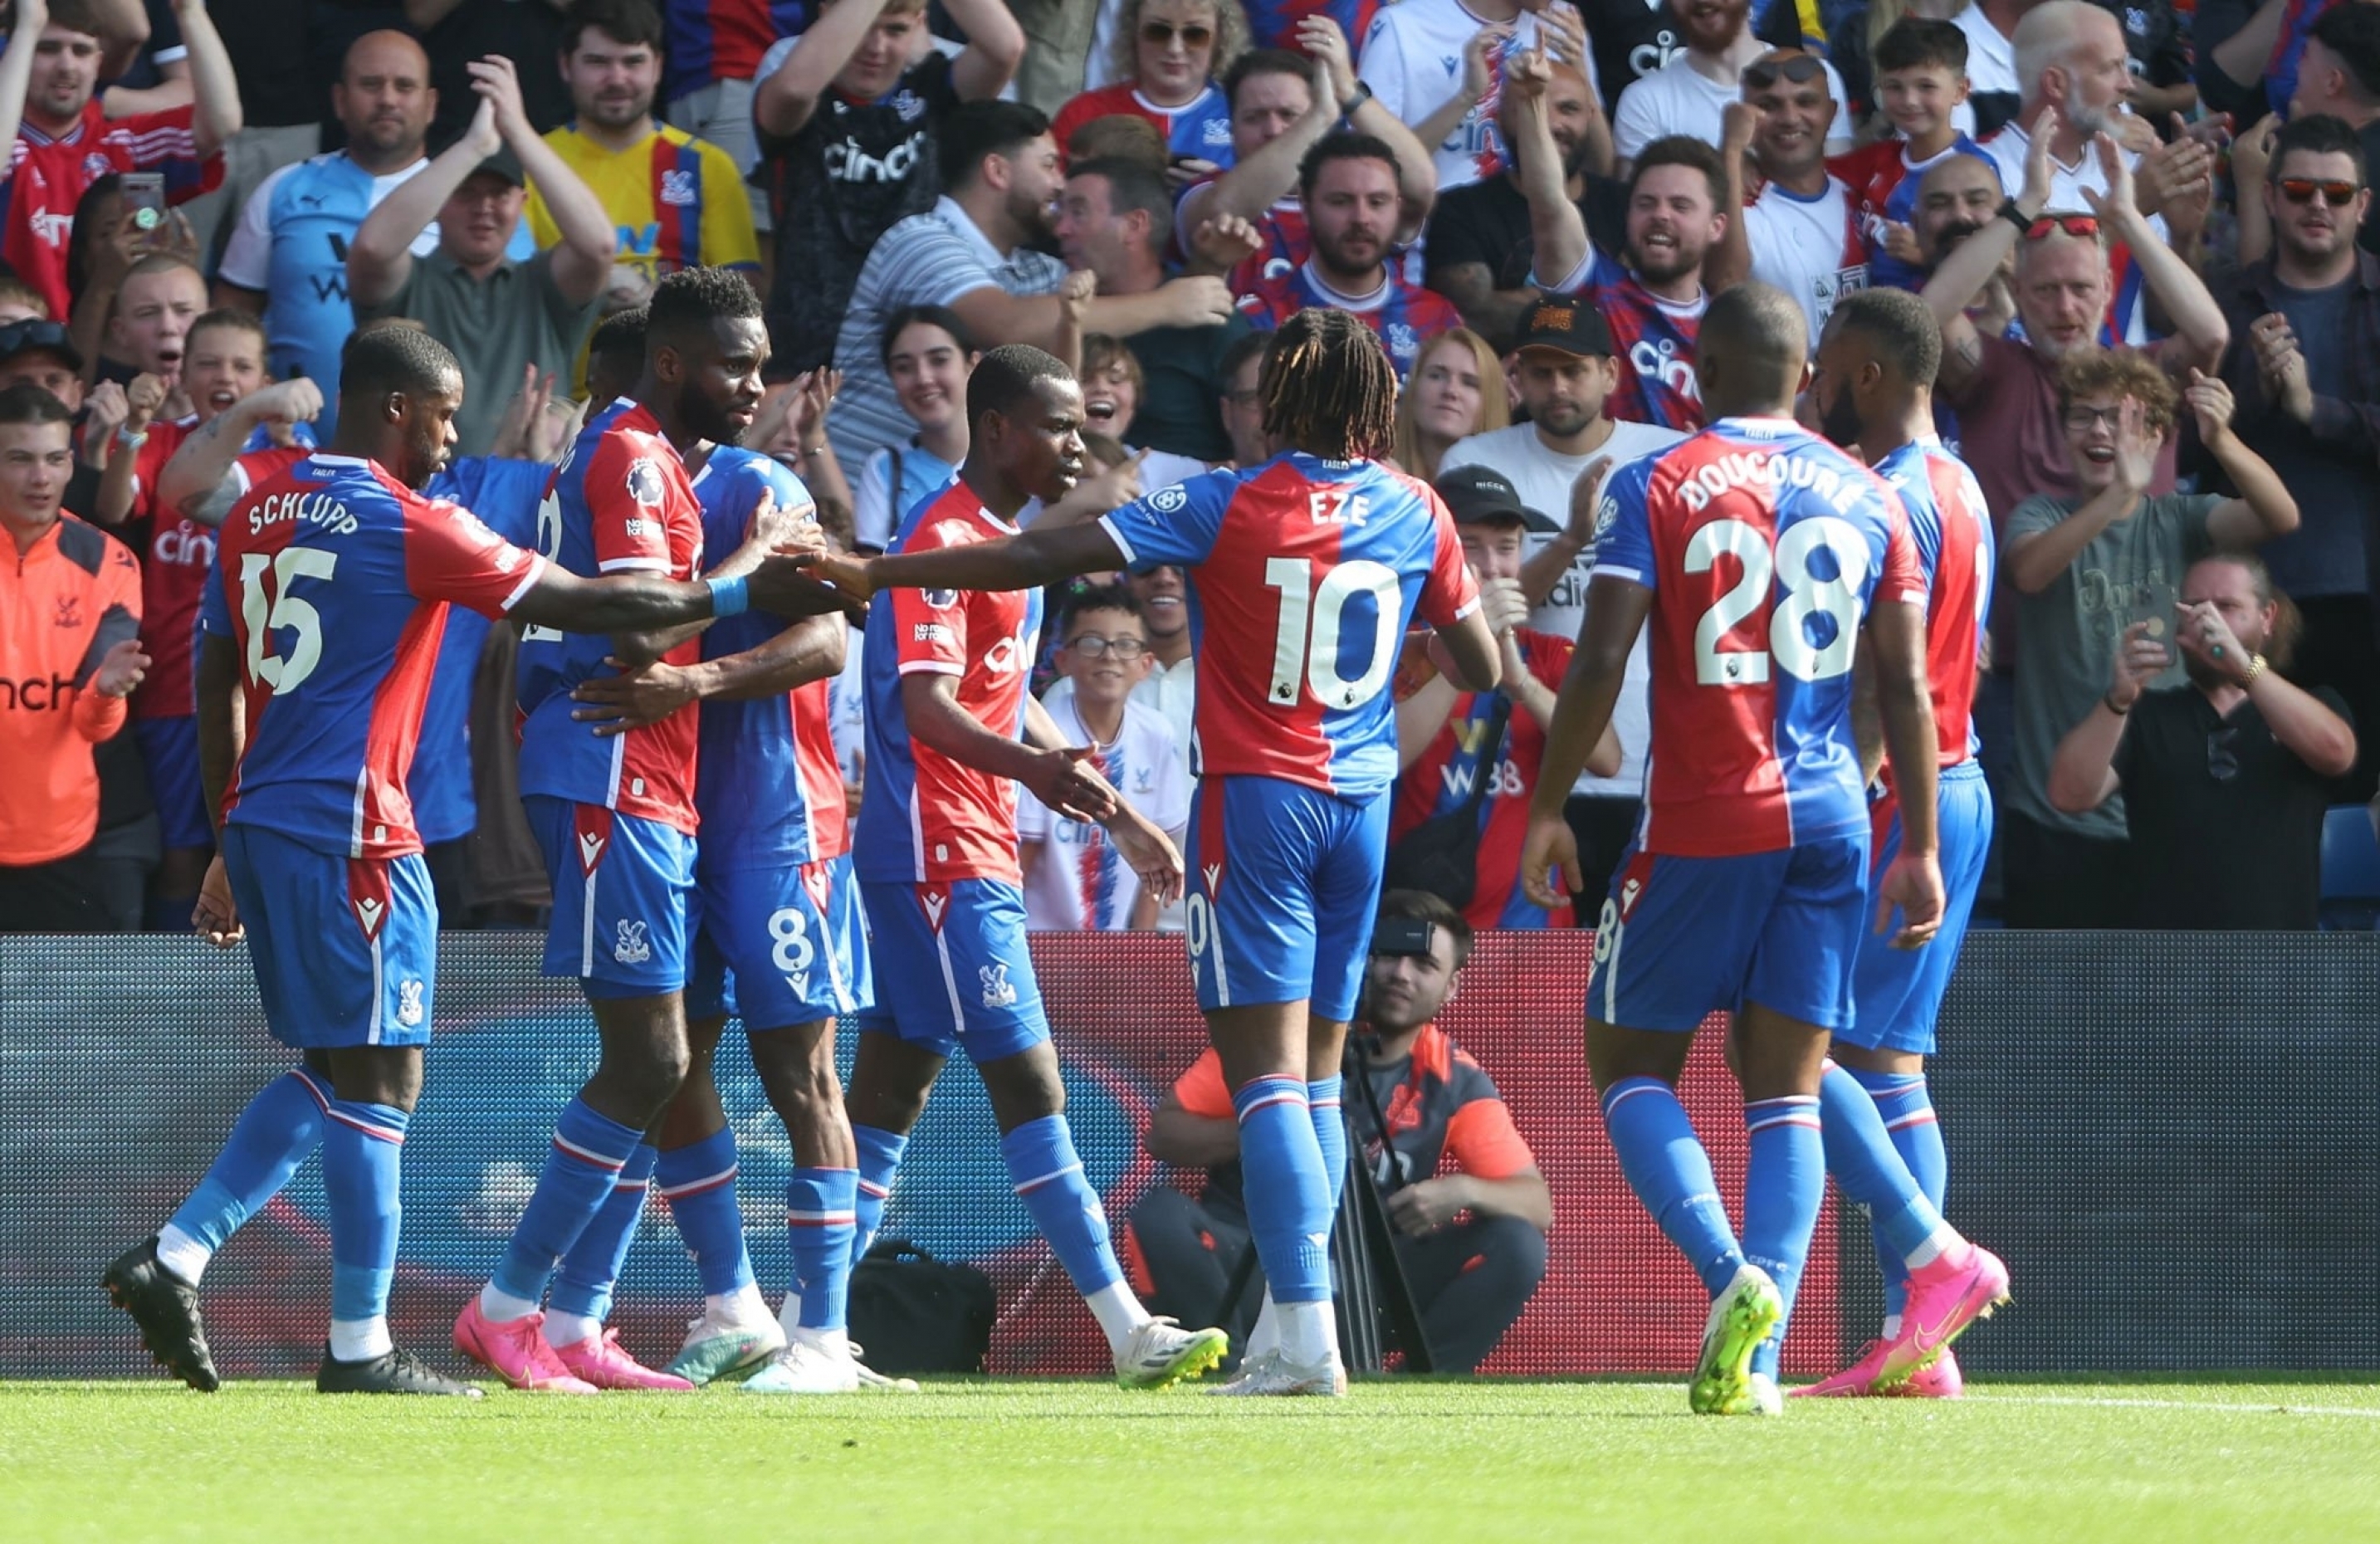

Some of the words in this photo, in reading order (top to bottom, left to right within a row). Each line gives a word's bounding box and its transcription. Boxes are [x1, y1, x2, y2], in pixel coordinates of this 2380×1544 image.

[248, 491, 359, 535] SCHLUPP
[1310, 491, 1370, 527] EZE
[239, 546, 338, 696] 15
[1265, 557, 1402, 711] 10
[1684, 516, 1871, 686] 28
[767, 907, 814, 972] 8
